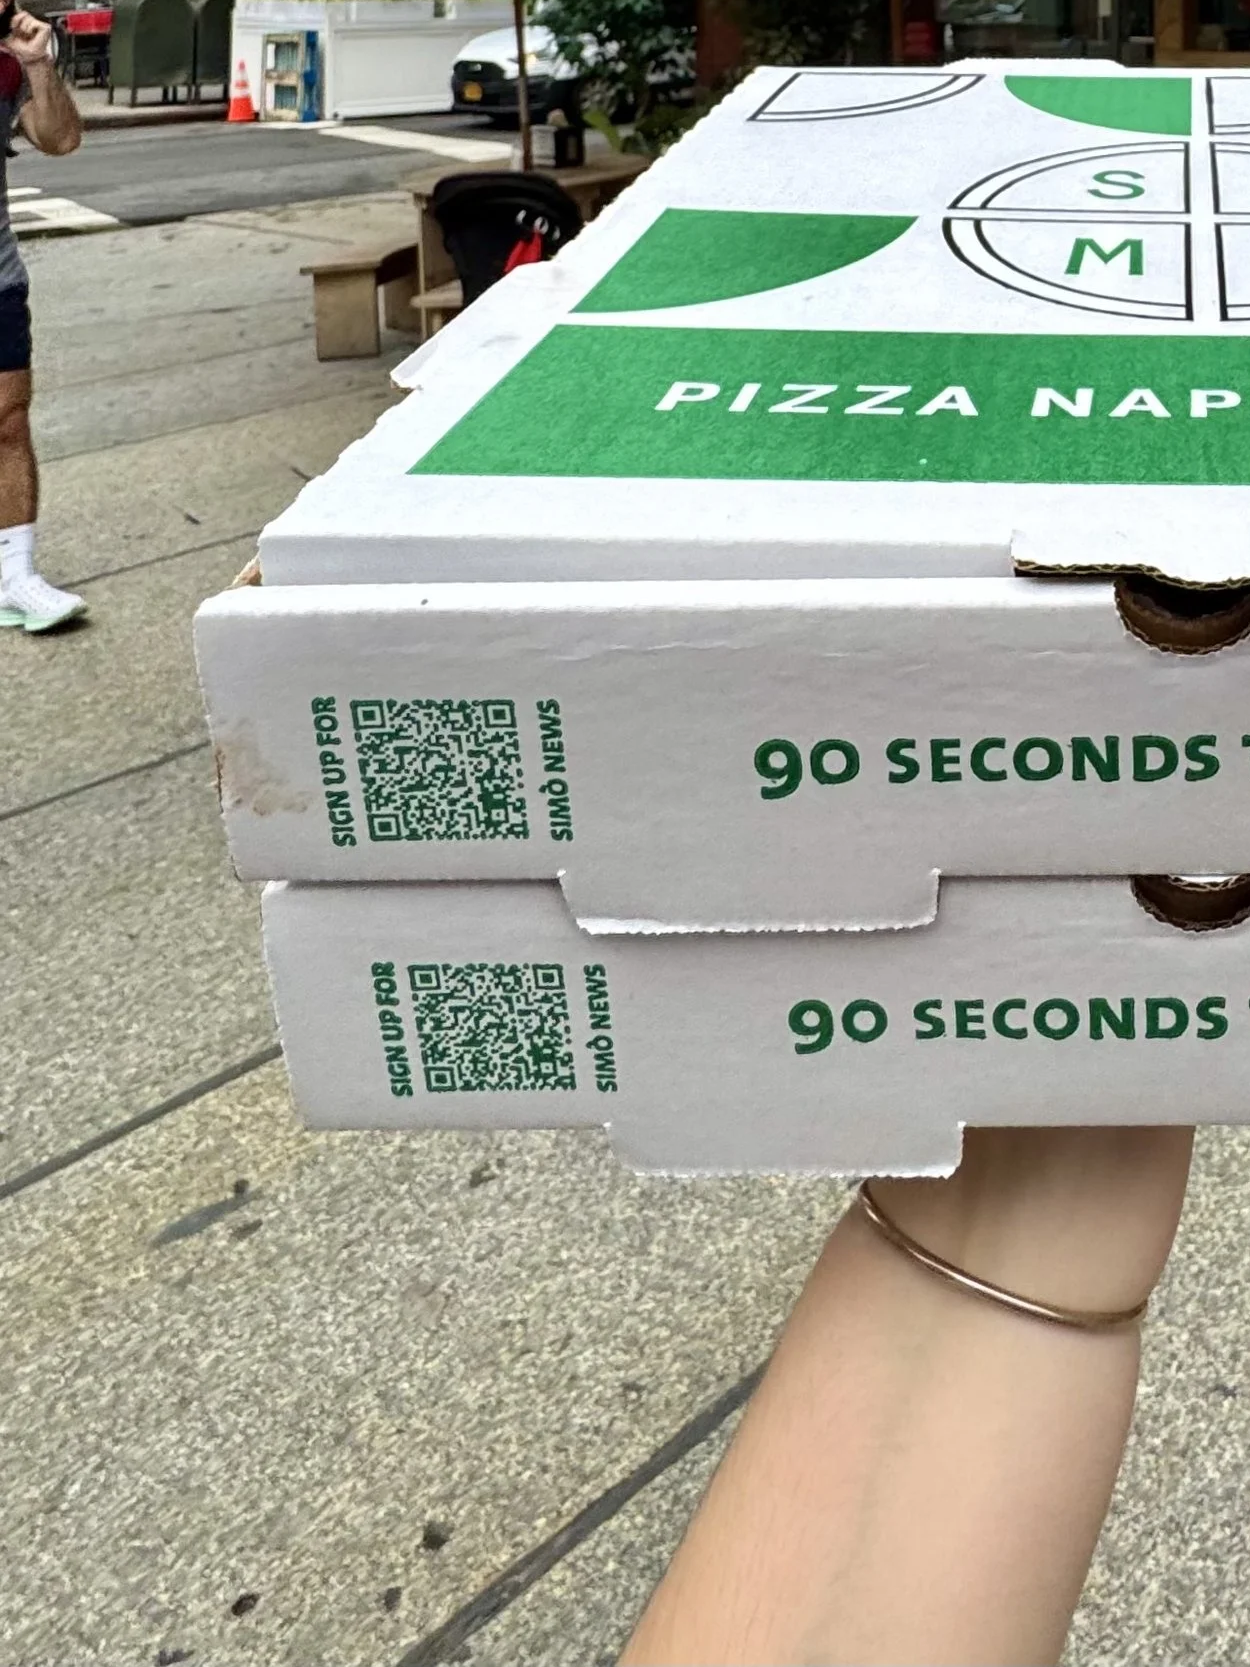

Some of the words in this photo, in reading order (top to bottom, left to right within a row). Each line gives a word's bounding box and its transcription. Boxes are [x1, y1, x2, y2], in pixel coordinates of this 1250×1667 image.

[653, 380, 980, 416] PIZZA
[311, 696, 342, 746] FOR
[536, 698, 567, 773] NEWS
[319, 749, 347, 786] UP
[753, 737, 860, 800] 90
[885, 733, 1221, 784] SECONDS
[325, 790, 358, 847] SIGN
[371, 961, 401, 1006] FOR
[583, 963, 612, 1030] NEWS
[378, 1009, 405, 1042] UP
[787, 998, 889, 1056] 90
[912, 995, 1230, 1041] SECONDS
[384, 1045, 414, 1097] SIGN
